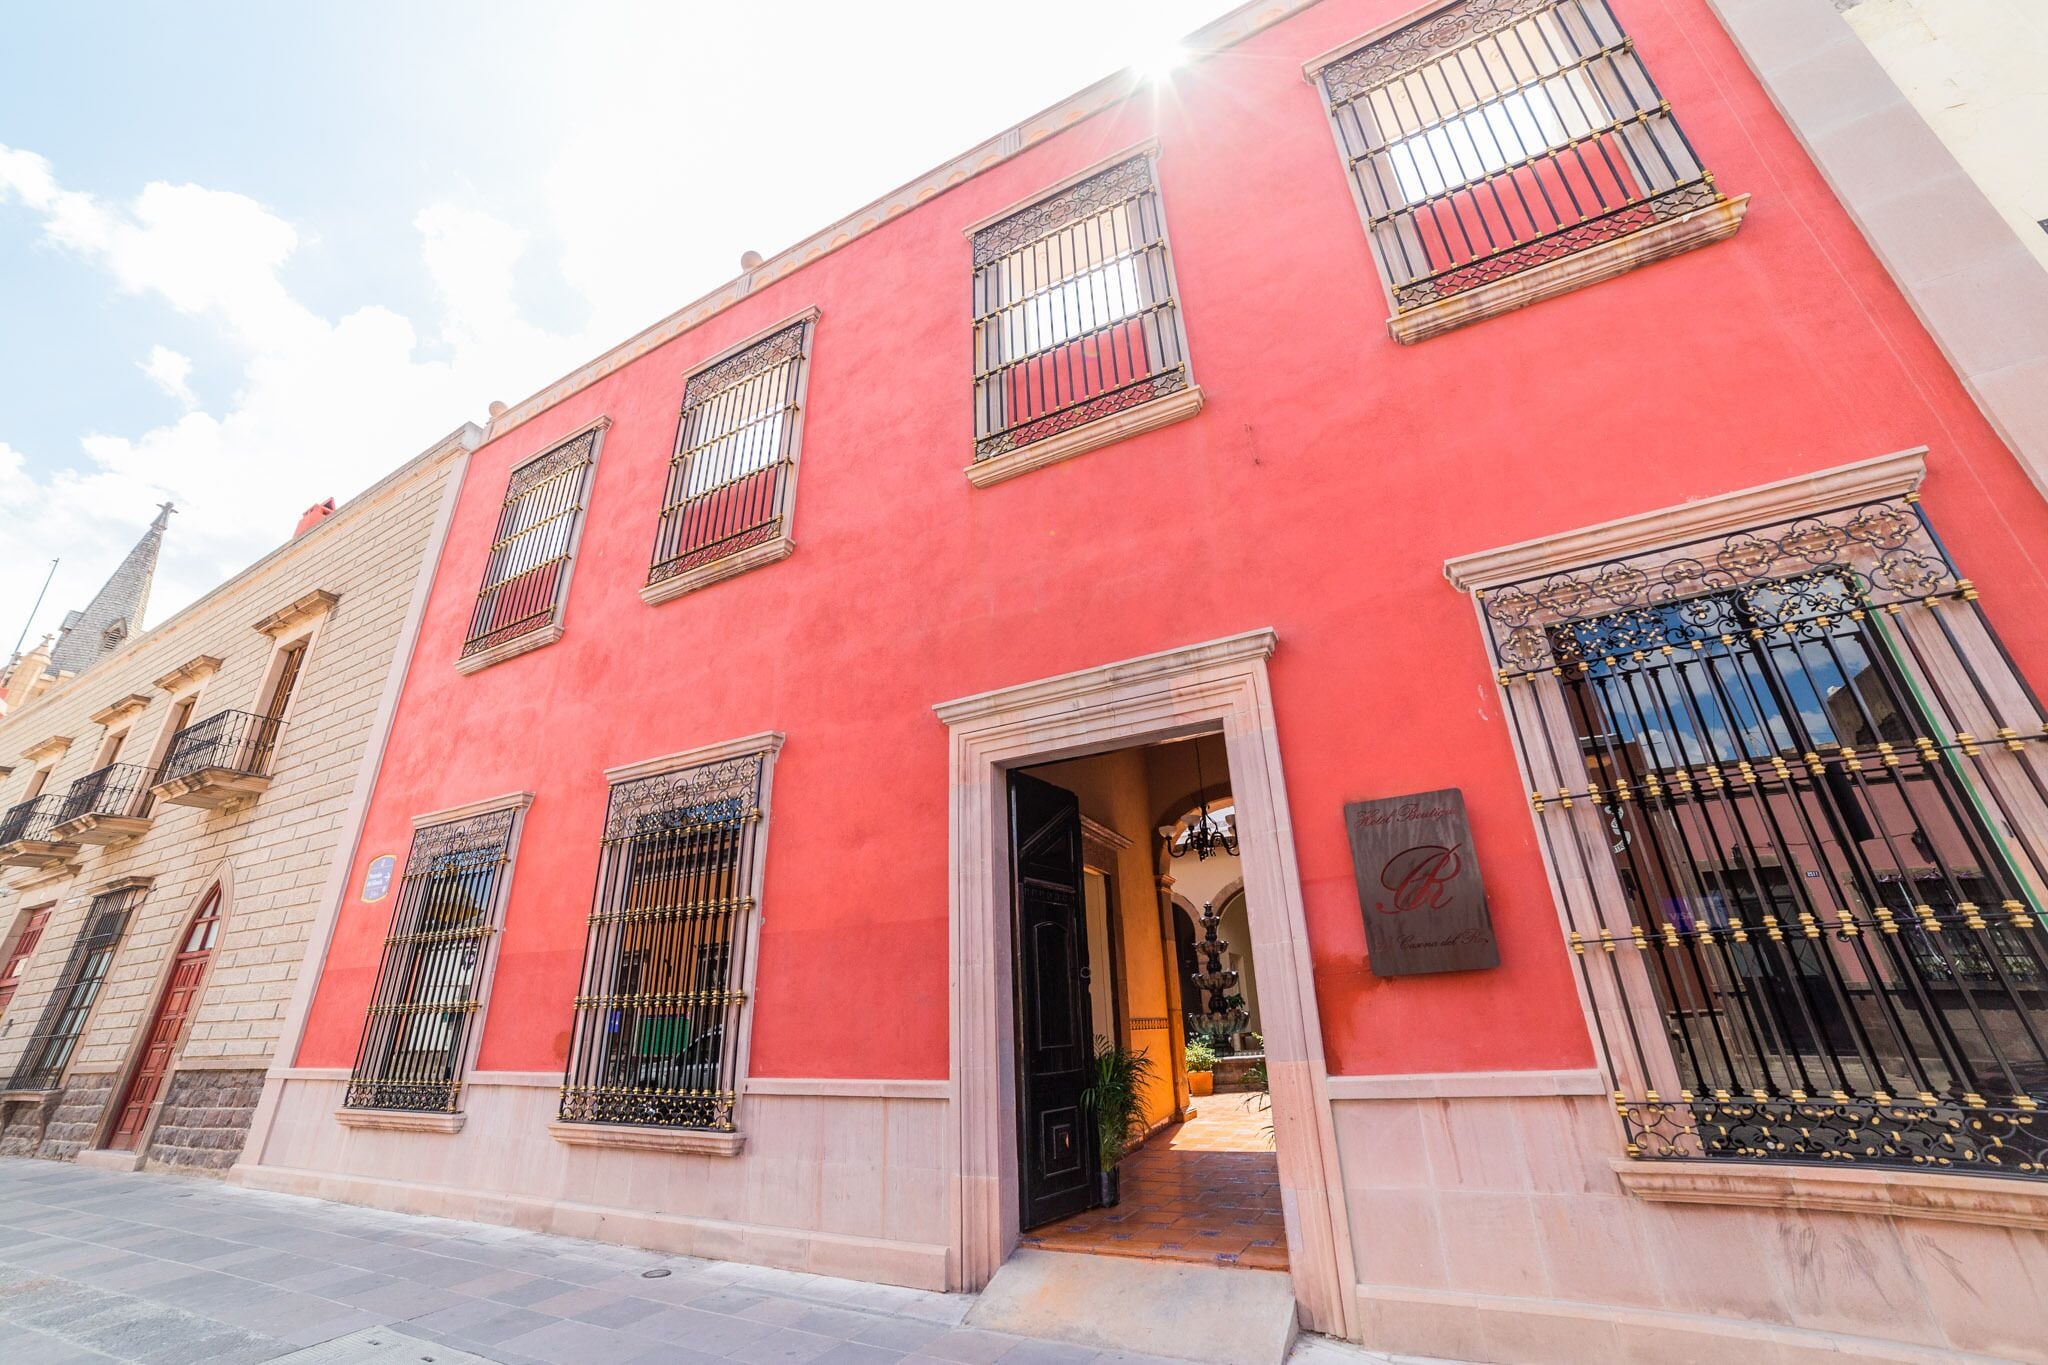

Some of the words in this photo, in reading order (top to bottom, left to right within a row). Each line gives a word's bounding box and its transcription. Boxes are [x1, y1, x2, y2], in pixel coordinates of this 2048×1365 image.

[1356, 808, 1397, 827] Hotel
[1397, 803, 1458, 823] Boutique
[1440, 932, 1462, 946] del
